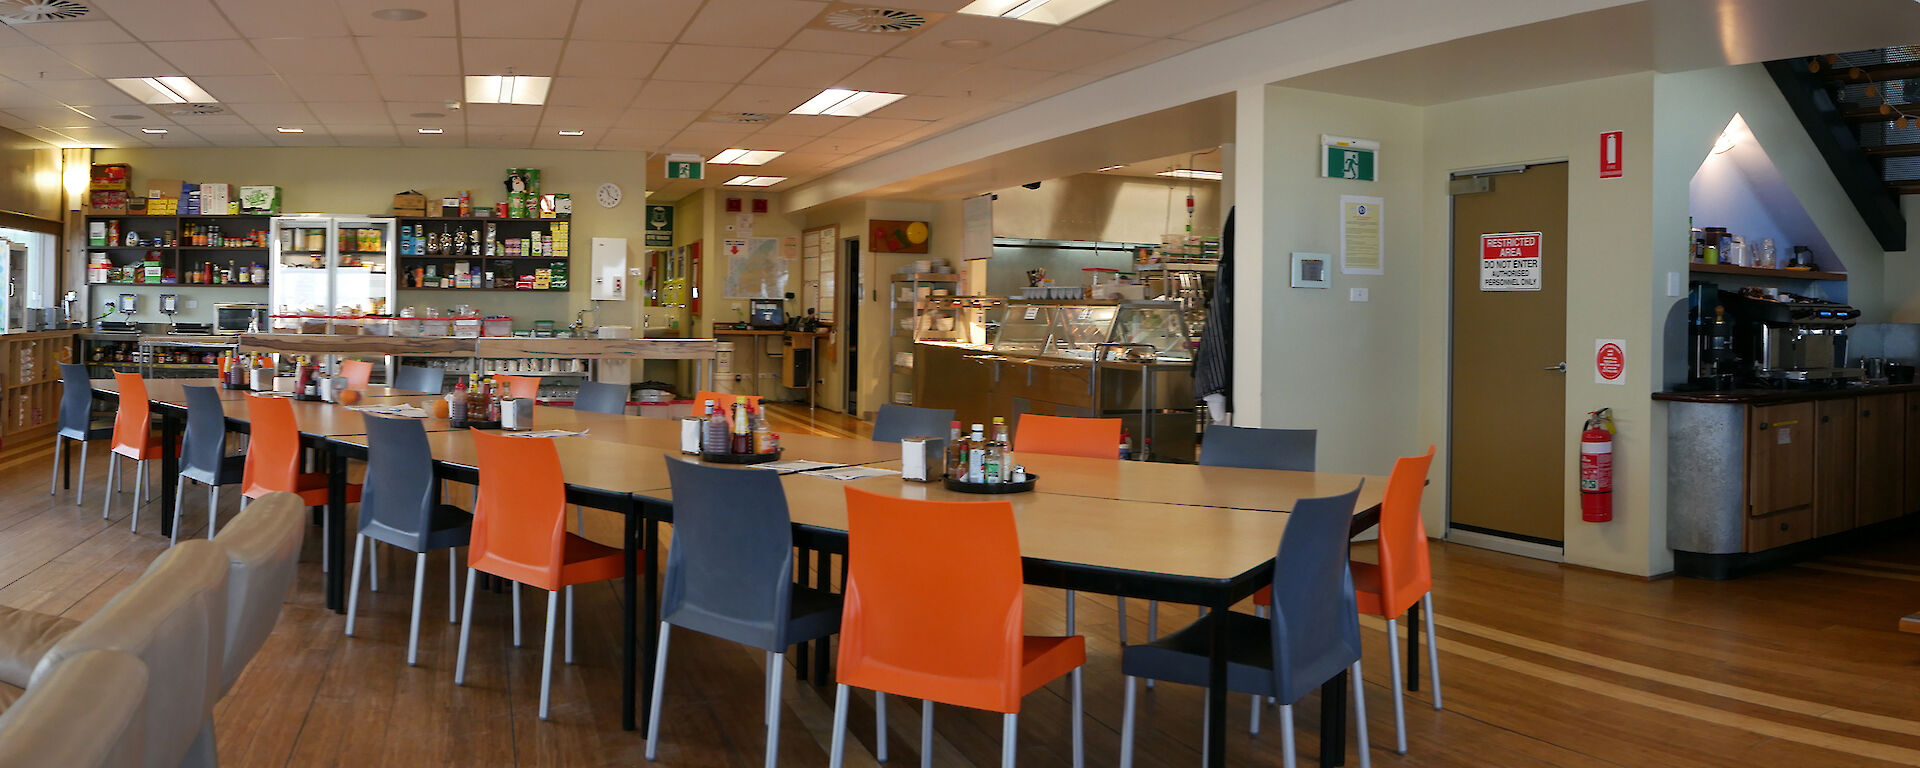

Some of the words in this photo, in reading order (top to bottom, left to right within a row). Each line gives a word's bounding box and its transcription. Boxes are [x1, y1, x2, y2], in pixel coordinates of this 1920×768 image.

[1487, 238, 1535, 247] RESTRICTED
[1500, 247, 1522, 257] AREA
[1484, 260, 1494, 269] DO
[1497, 260, 1512, 269] NOT
[1513, 259, 1538, 268] ENTER
[1492, 269, 1529, 277] AUTHORISED
[1485, 278, 1520, 286] PERSONNEL
[1521, 278, 1537, 286] ONLY
